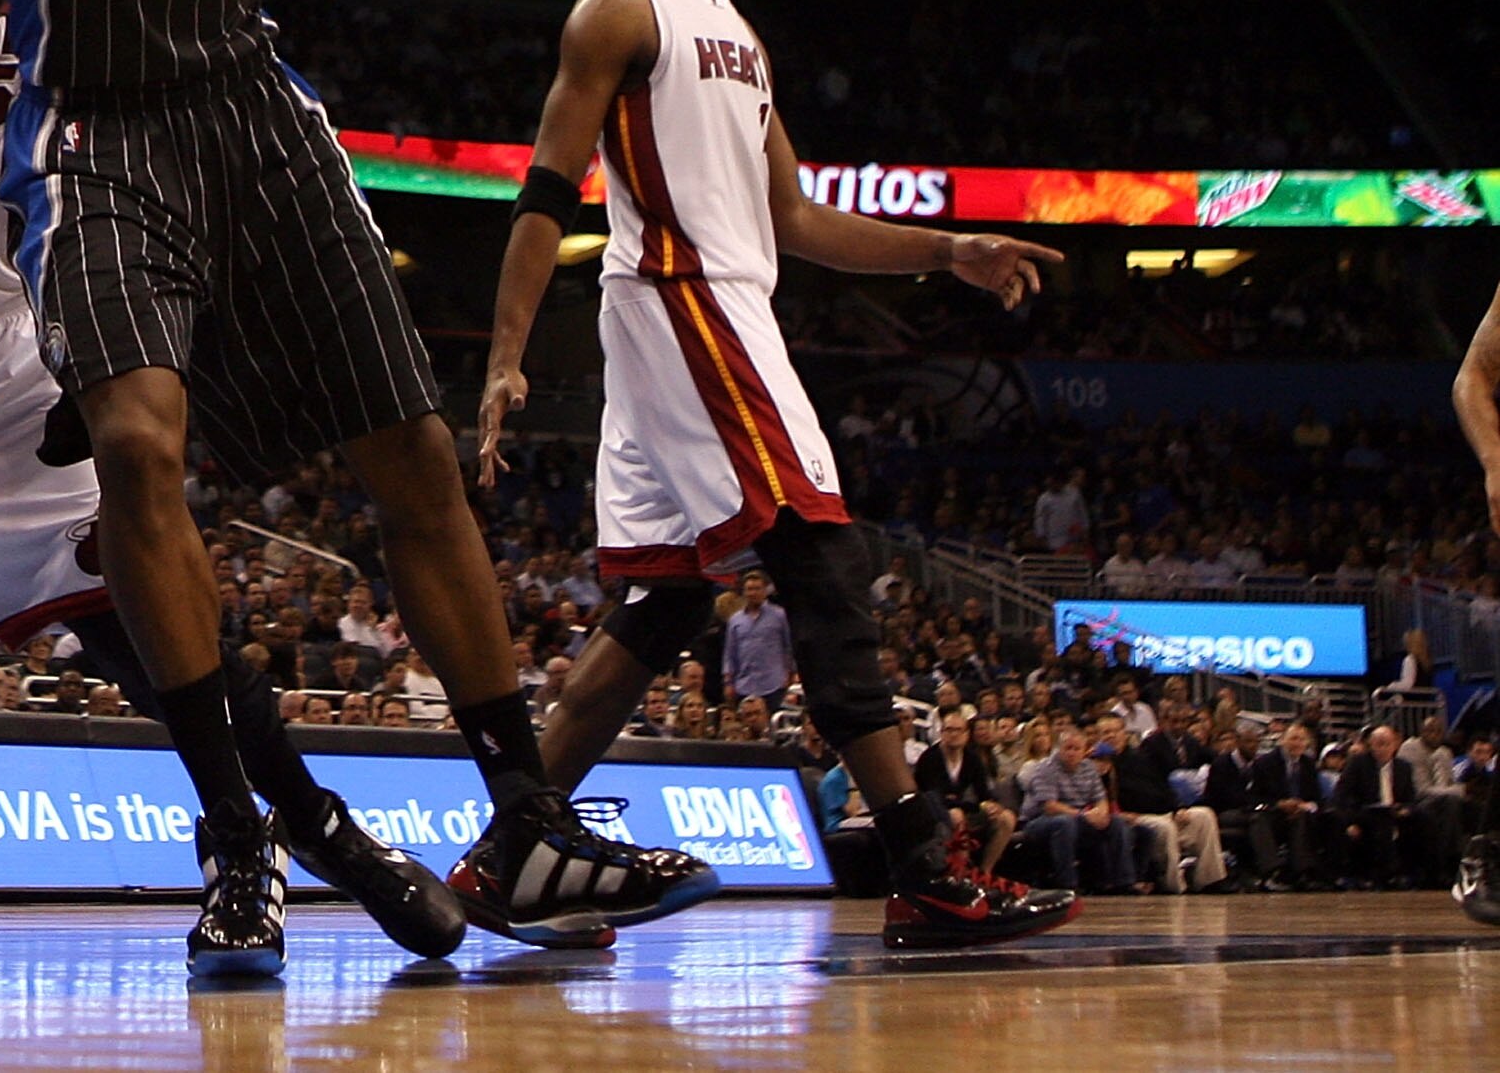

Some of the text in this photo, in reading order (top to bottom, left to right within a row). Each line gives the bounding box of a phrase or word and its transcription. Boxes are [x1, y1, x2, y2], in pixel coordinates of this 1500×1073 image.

[1051, 376, 1108, 409] 108
[1133, 635, 1315, 670] PEPSICO
[69, 792, 115, 842] is
[115, 793, 195, 843] the
[442, 799, 484, 845] of
[661, 786, 776, 838] BBVA
